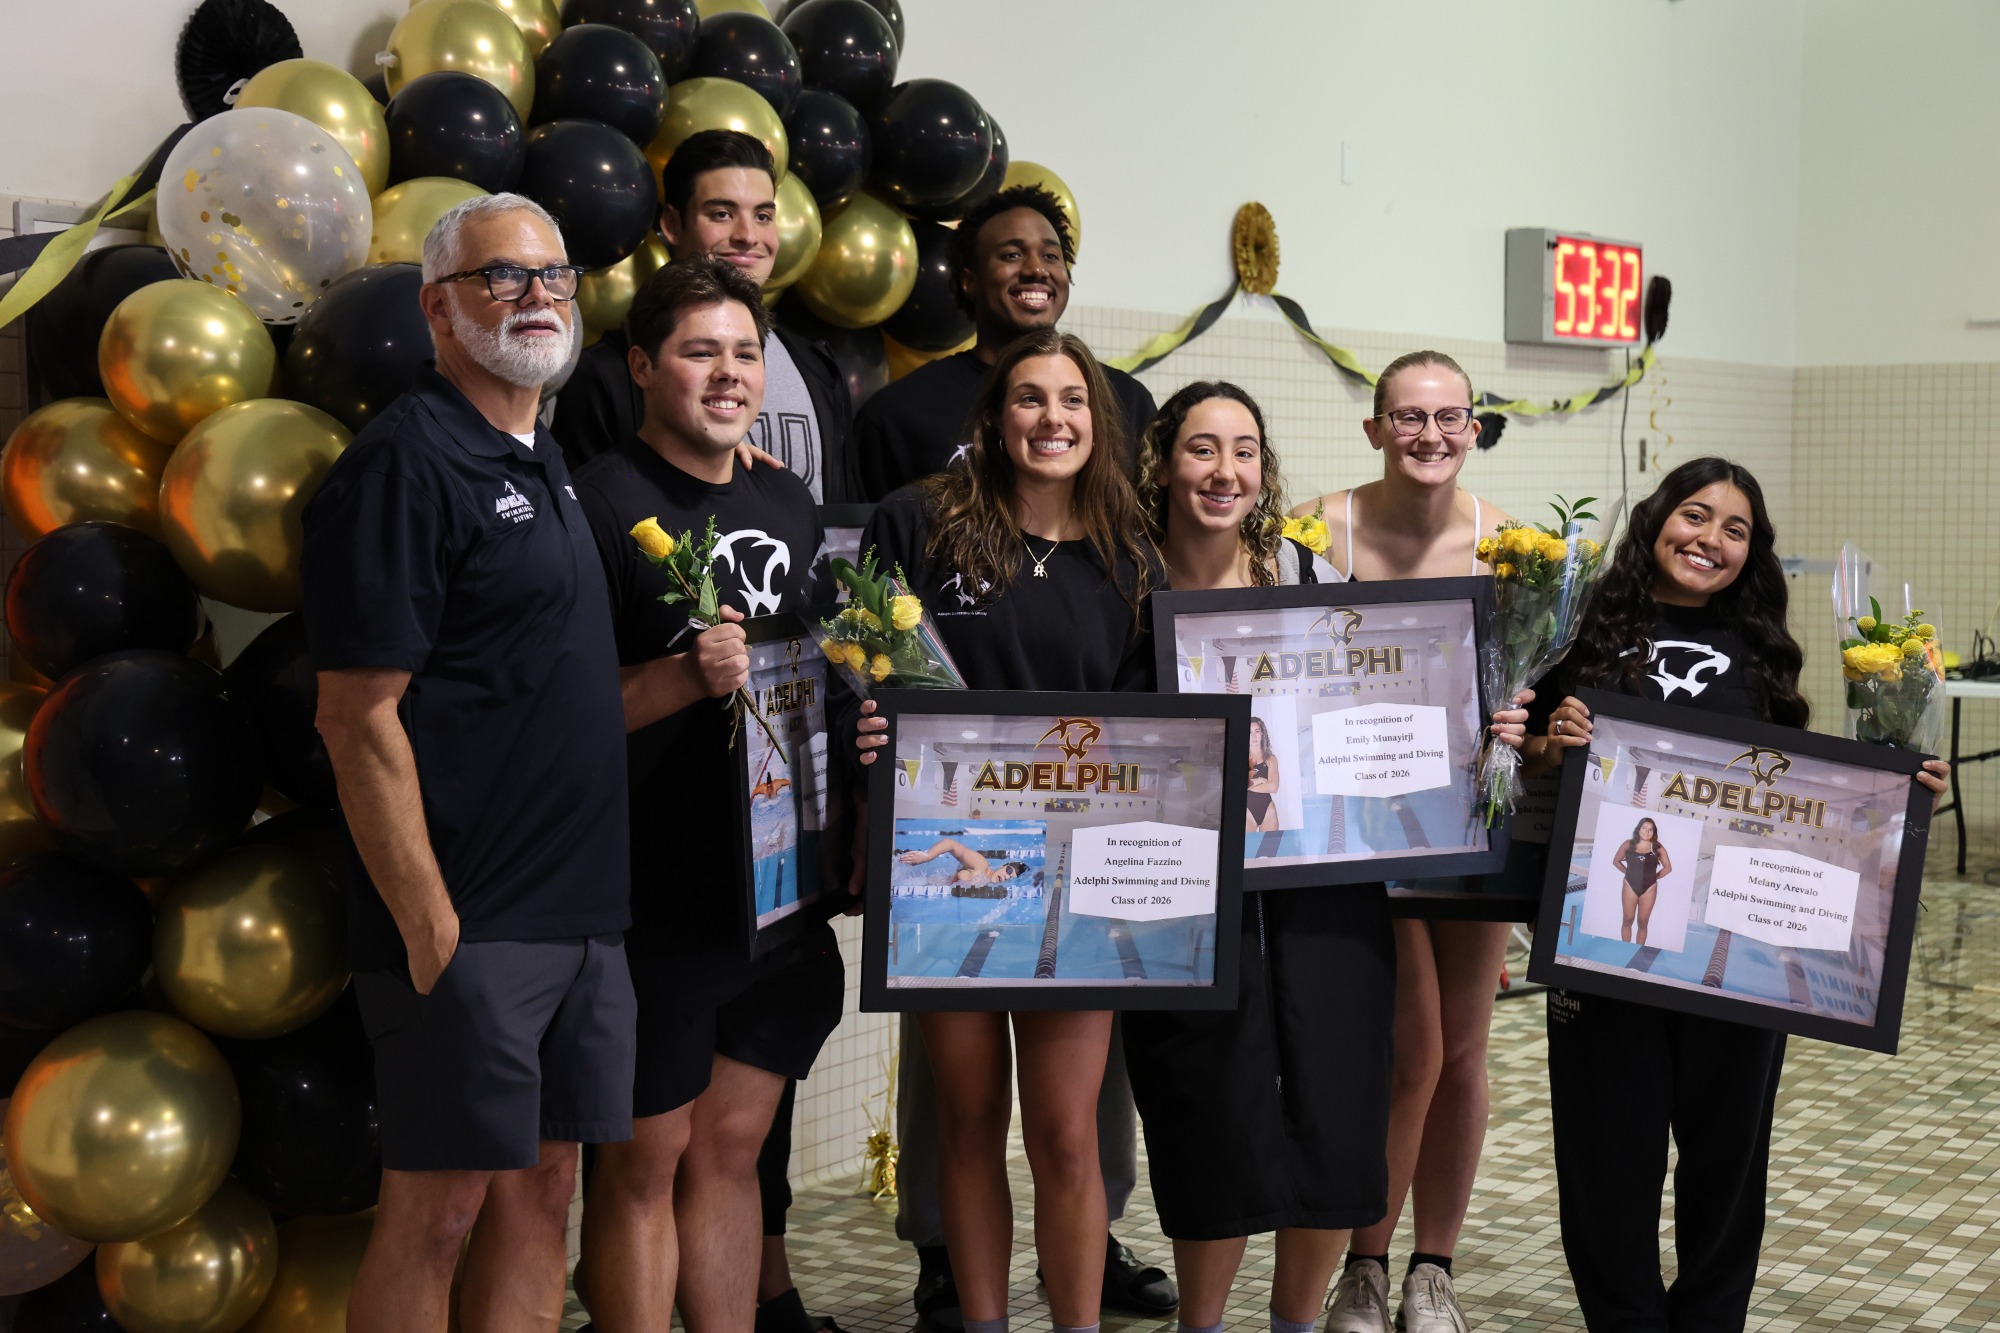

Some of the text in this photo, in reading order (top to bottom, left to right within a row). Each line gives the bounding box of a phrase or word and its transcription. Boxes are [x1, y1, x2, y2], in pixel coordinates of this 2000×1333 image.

[1555, 243, 1639, 337] 53:32
[513, 513, 534, 523] DIVING
[1250, 645, 1403, 682] ADELPHI
[766, 675, 815, 717] ADELPHI
[1345, 714, 1414, 726] In recognition of
[1346, 732, 1414, 745] Emily Munayirji
[1318, 749, 1444, 765] Adelphi Swimming and Diving
[971, 759, 1140, 793] ADELPHI
[1354, 770, 1410, 781] Class of 2026
[1660, 770, 1827, 829] ADELPHI
[1107, 838, 1182, 849] In recognition of
[1104, 857, 1182, 867] Angelina Fazzino
[1749, 857, 1824, 879] In recognition of
[1073, 876, 1211, 888] Adelphi Swimming and Diving
[1748, 875, 1819, 897] Melany Arevalo
[1111, 896, 1172, 905] Class of 2026
[1712, 888, 1848, 923] Adelphi Swimming and Diving
[1747, 913, 1808, 932] Class of 2026
